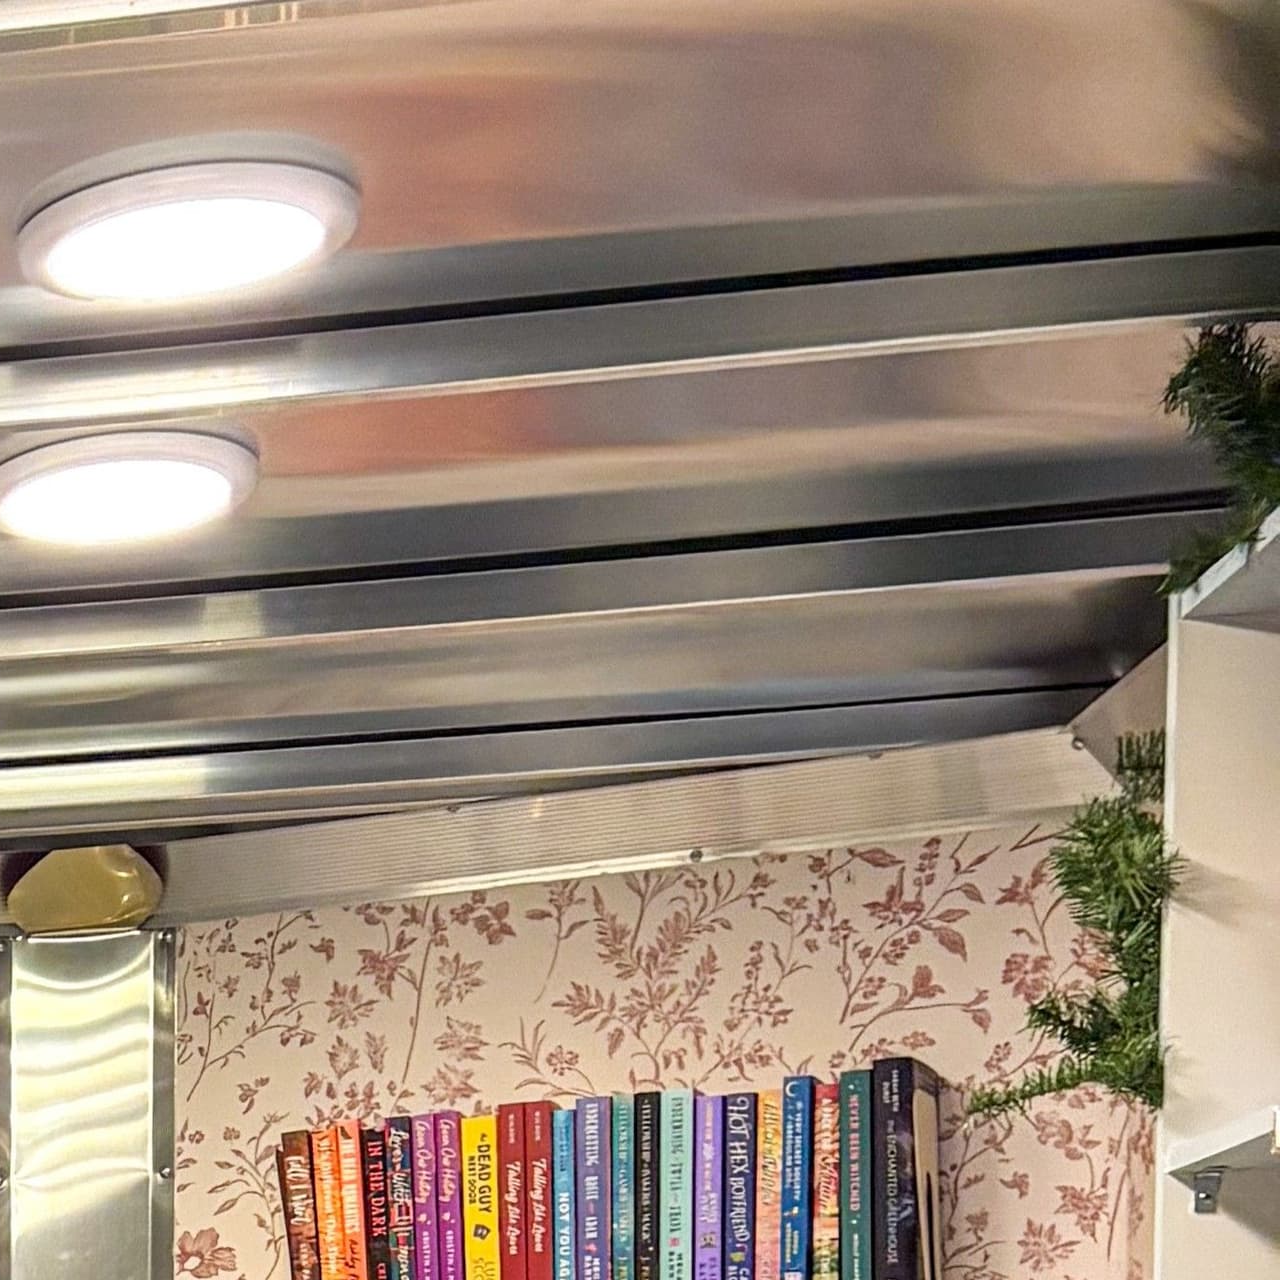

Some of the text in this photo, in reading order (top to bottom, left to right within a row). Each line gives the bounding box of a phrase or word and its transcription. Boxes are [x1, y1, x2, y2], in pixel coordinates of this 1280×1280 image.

[367, 1141, 387, 1237] IN THE DARK
[476, 1144, 492, 1214] DEAD GUY
[729, 1097, 750, 1242] HOT HEX BOYFRIEND
[559, 1192, 570, 1221] NOT
[559, 1226, 570, 1255] YOU
